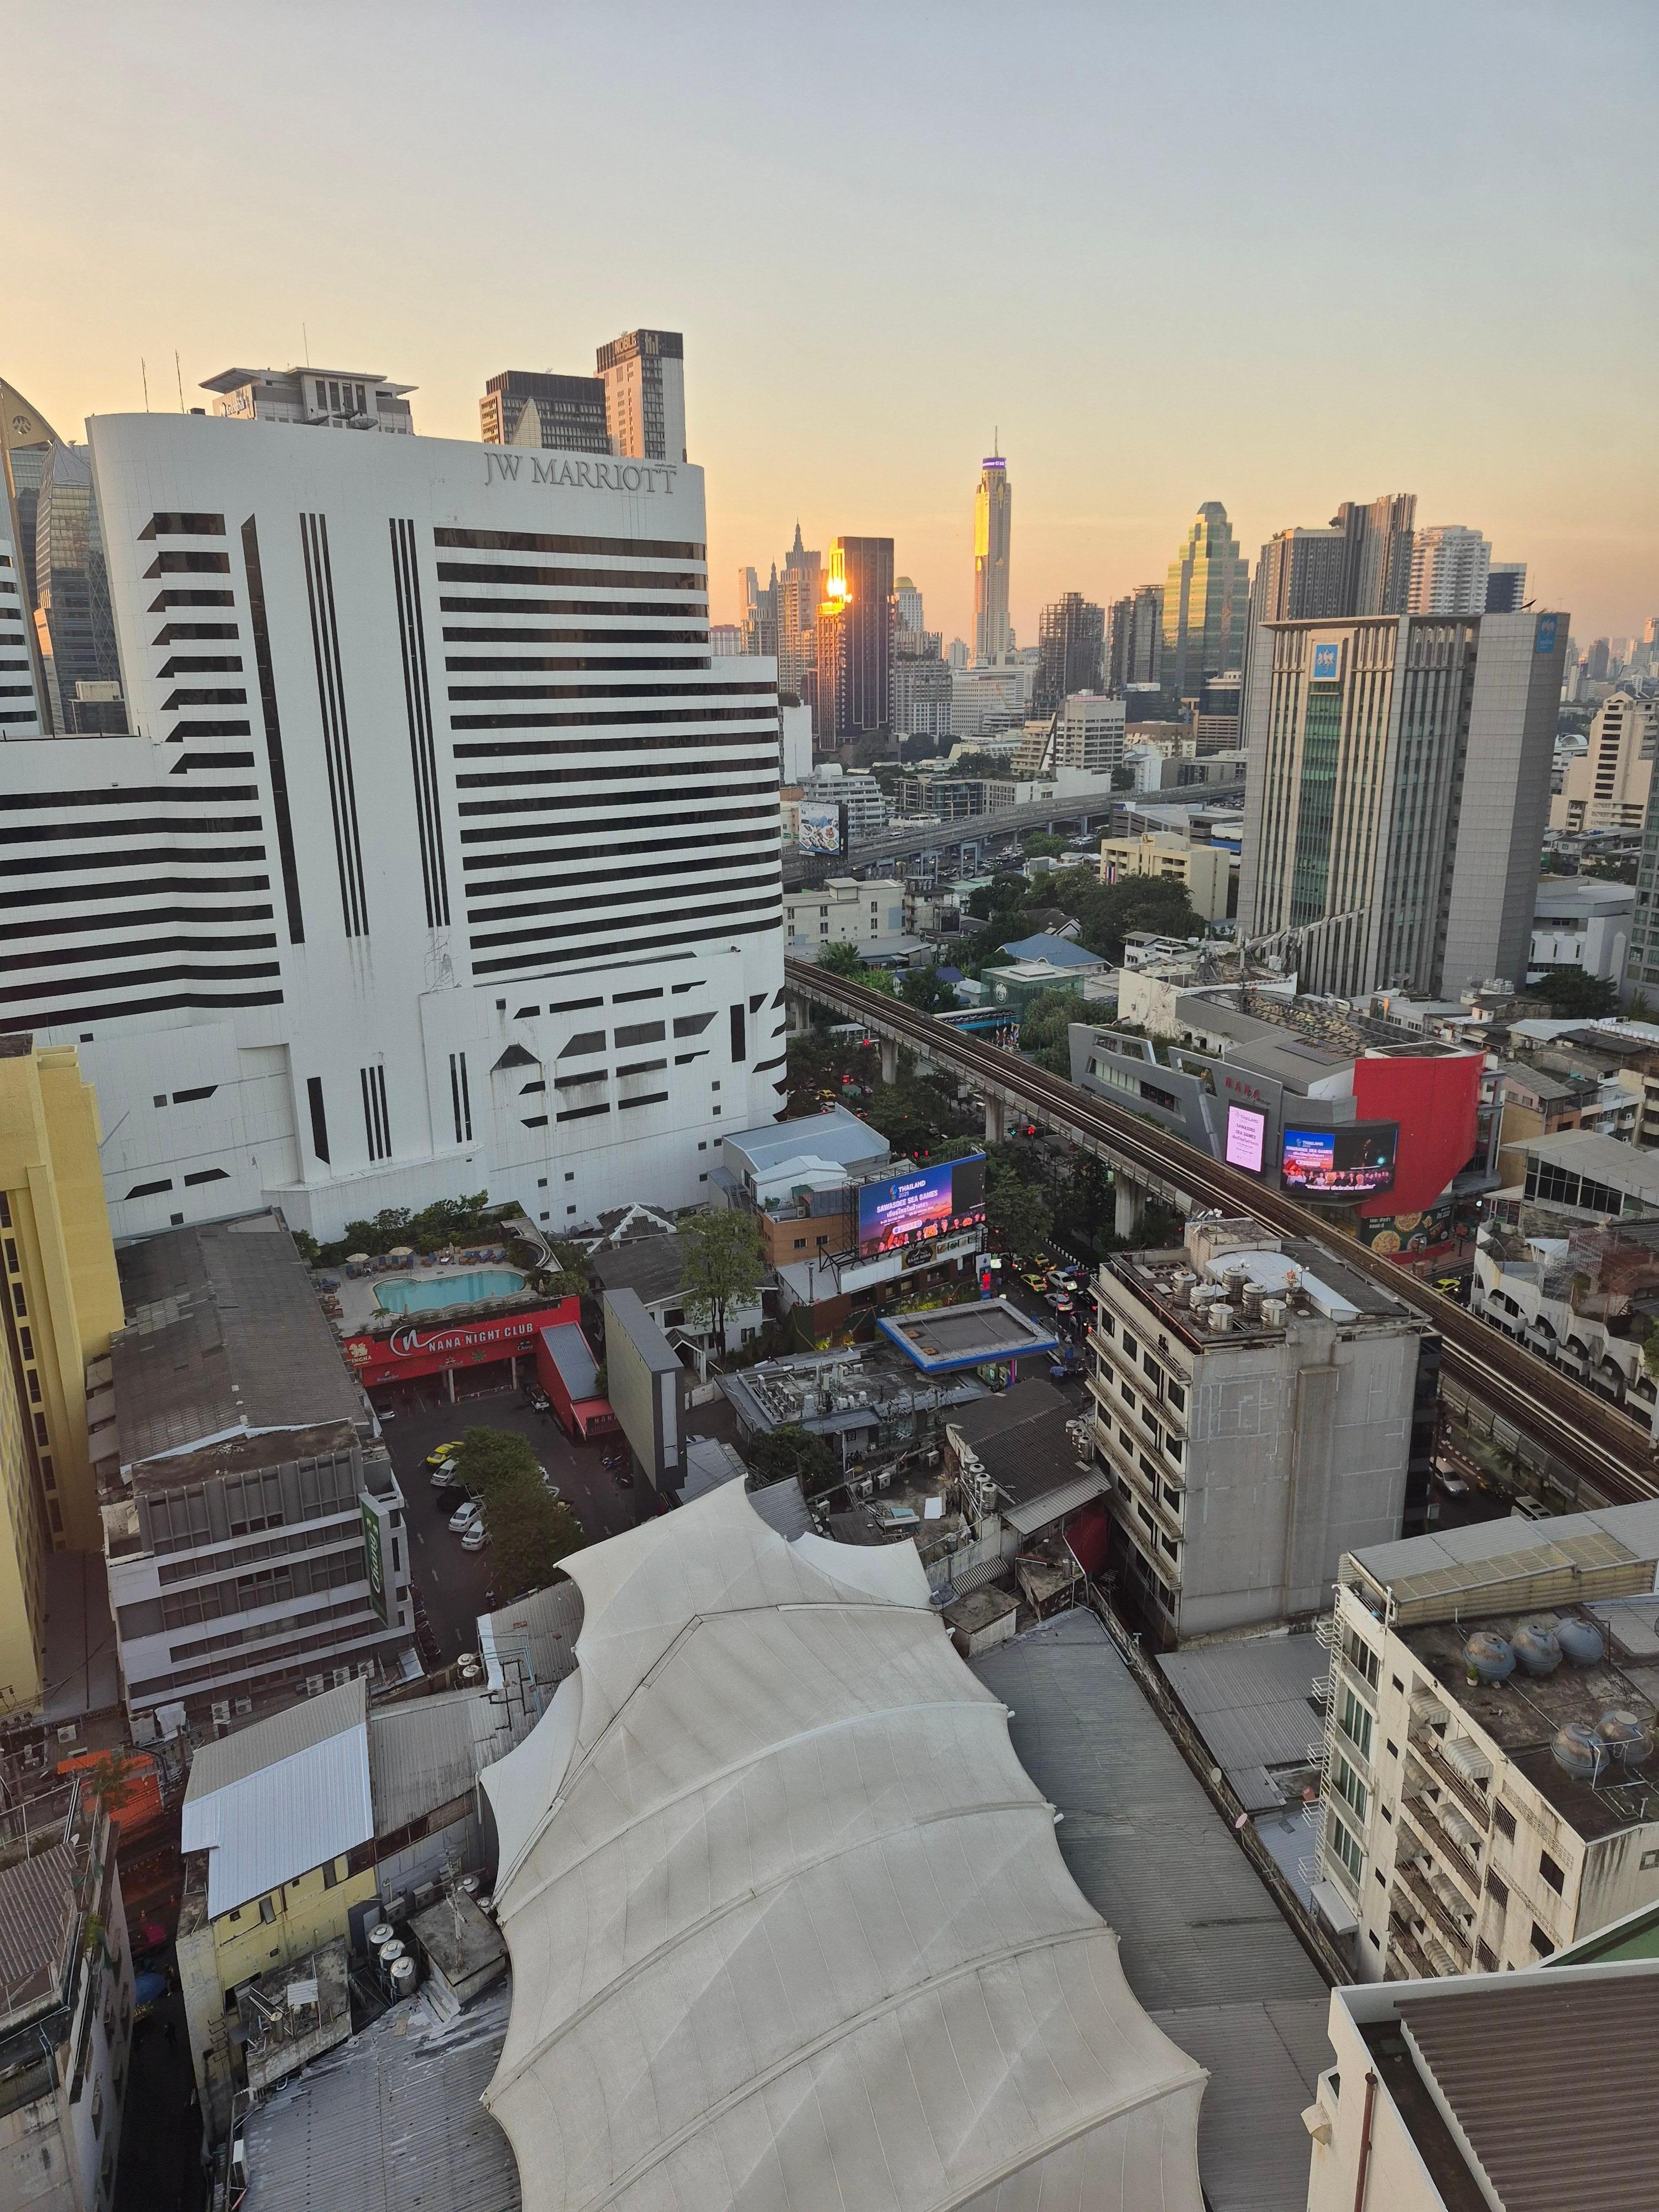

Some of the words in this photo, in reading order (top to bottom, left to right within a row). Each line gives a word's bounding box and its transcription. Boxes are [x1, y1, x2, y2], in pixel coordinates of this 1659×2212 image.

[484, 452, 523, 486] JW
[530, 456, 677, 493] MARRIOTT
[898, 1180, 926, 1193] THAILAND
[876, 1199, 907, 1213] SAWASDEE
[907, 1196, 919, 1204] SEA
[919, 1190, 938, 1201] GAMES
[429, 1337, 461, 1352] NANA
[465, 1329, 500, 1345] NIGHT
[504, 1323, 534, 1337] CLUB
[352, 1355, 372, 1364] INGHA
[370, 1532, 380, 1594] Chang
